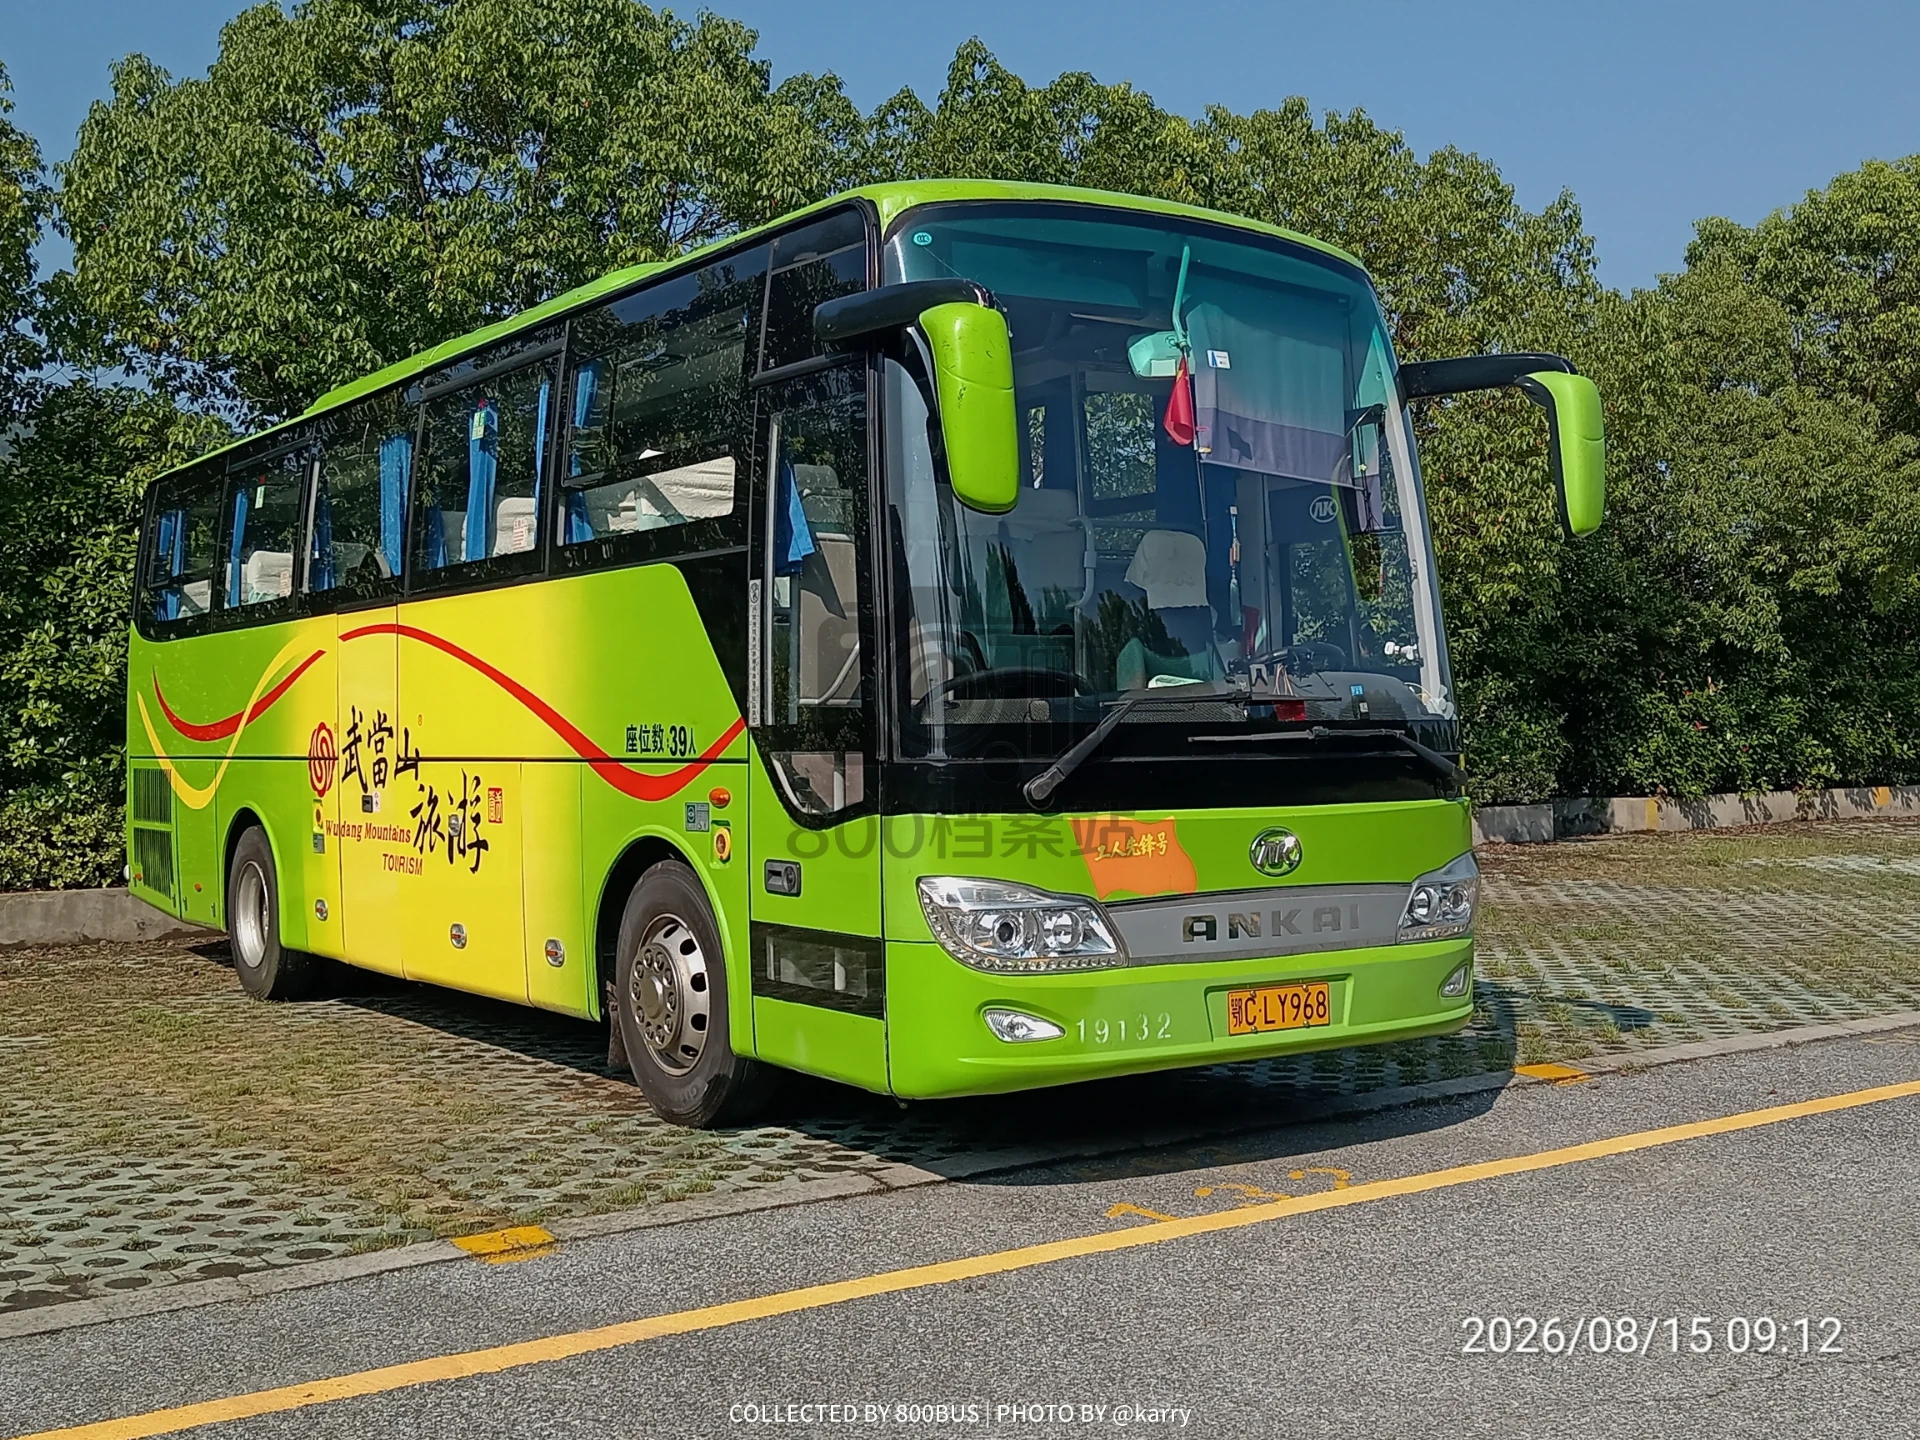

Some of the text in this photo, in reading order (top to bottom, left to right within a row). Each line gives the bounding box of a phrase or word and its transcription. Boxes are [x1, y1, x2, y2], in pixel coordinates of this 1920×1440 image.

[325, 820, 411, 843] Wudang Mountains
[1094, 832, 1168, 861] 工人先锋号
[382, 853, 423, 876] TOURISM
[1182, 904, 1360, 942] ANKAI
[1076, 1012, 1171, 1043] 19132
